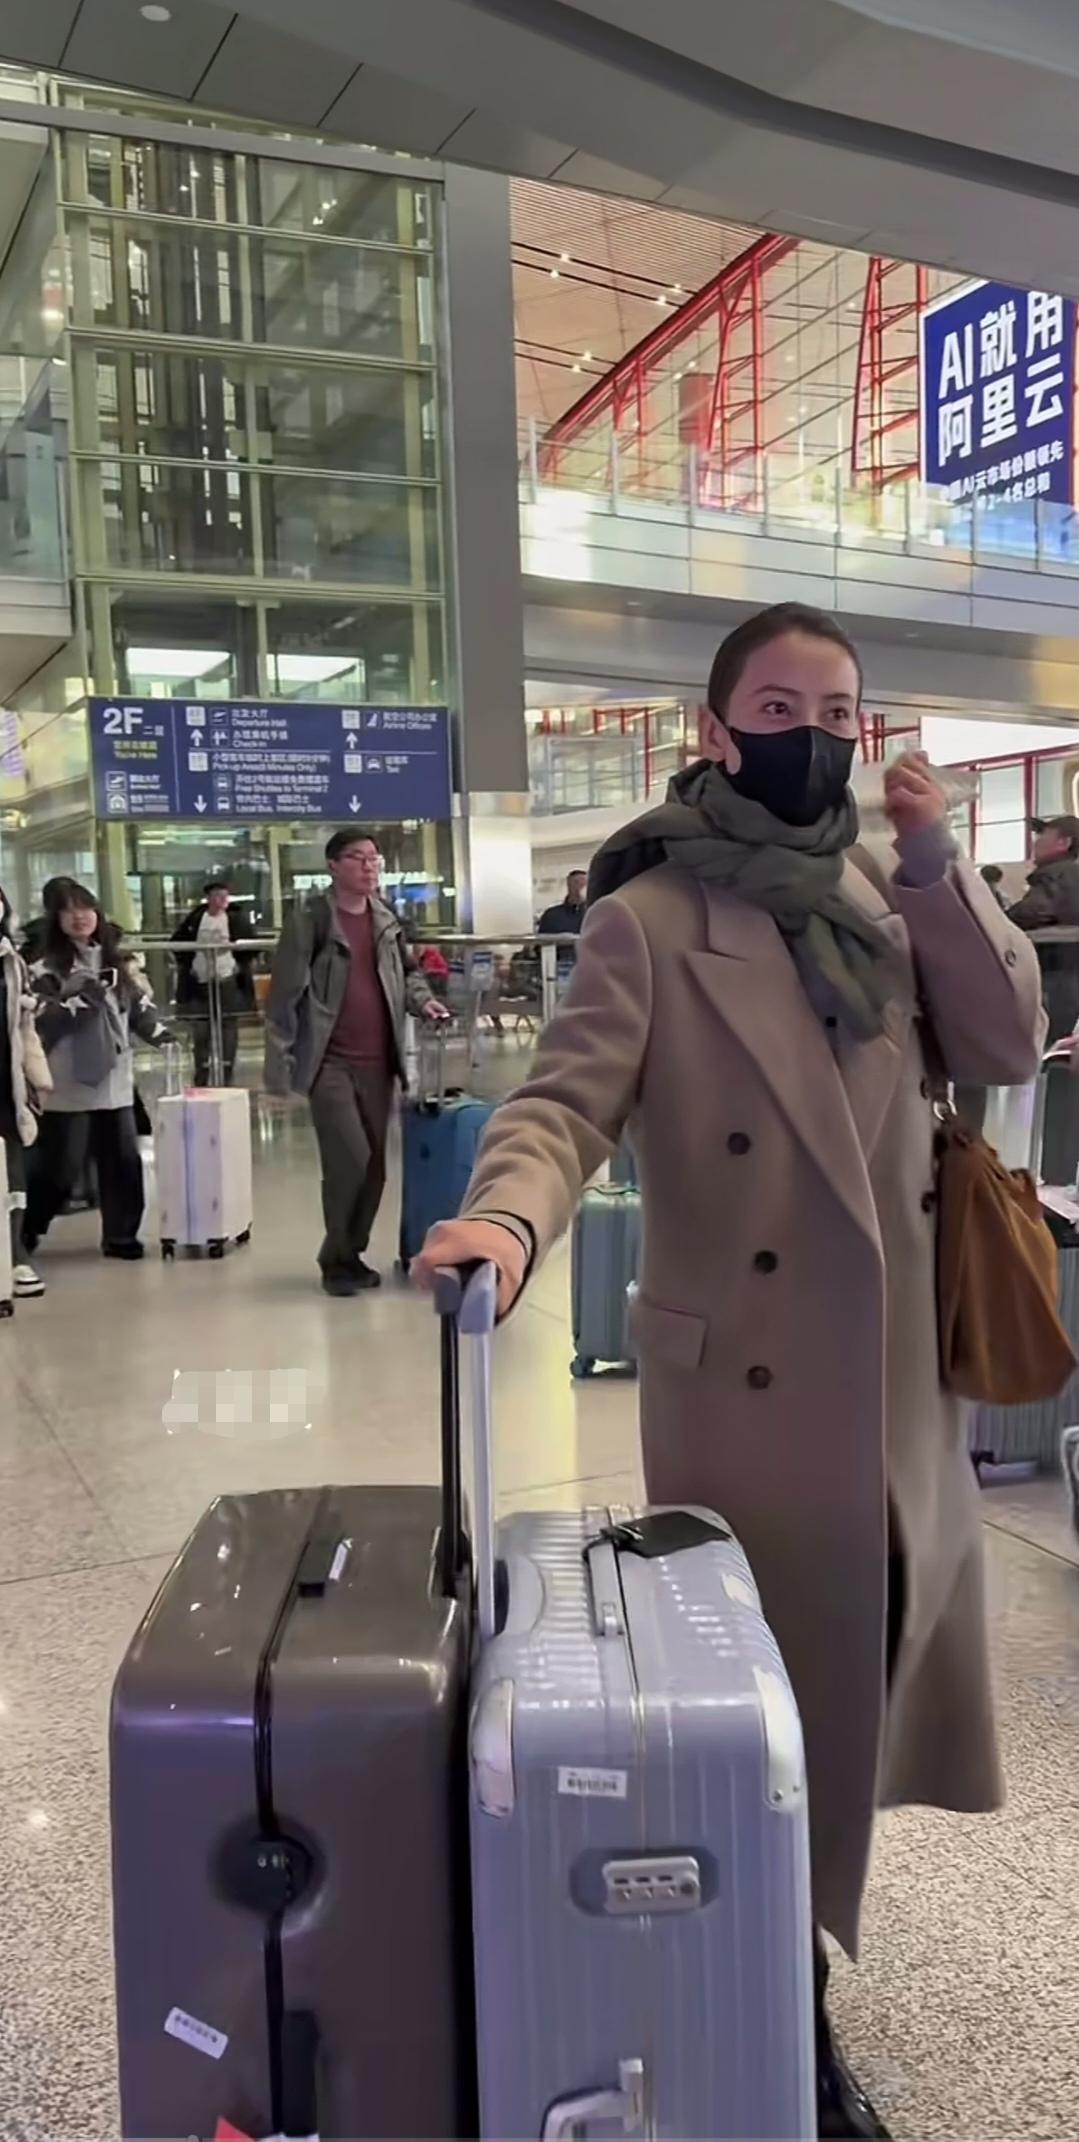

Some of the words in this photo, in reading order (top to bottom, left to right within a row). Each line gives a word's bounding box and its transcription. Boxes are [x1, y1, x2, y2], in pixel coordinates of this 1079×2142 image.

[939, 353, 1064, 467] 阿里云
[103, 707, 143, 734] 2F
[231, 719, 270, 727] Departure
